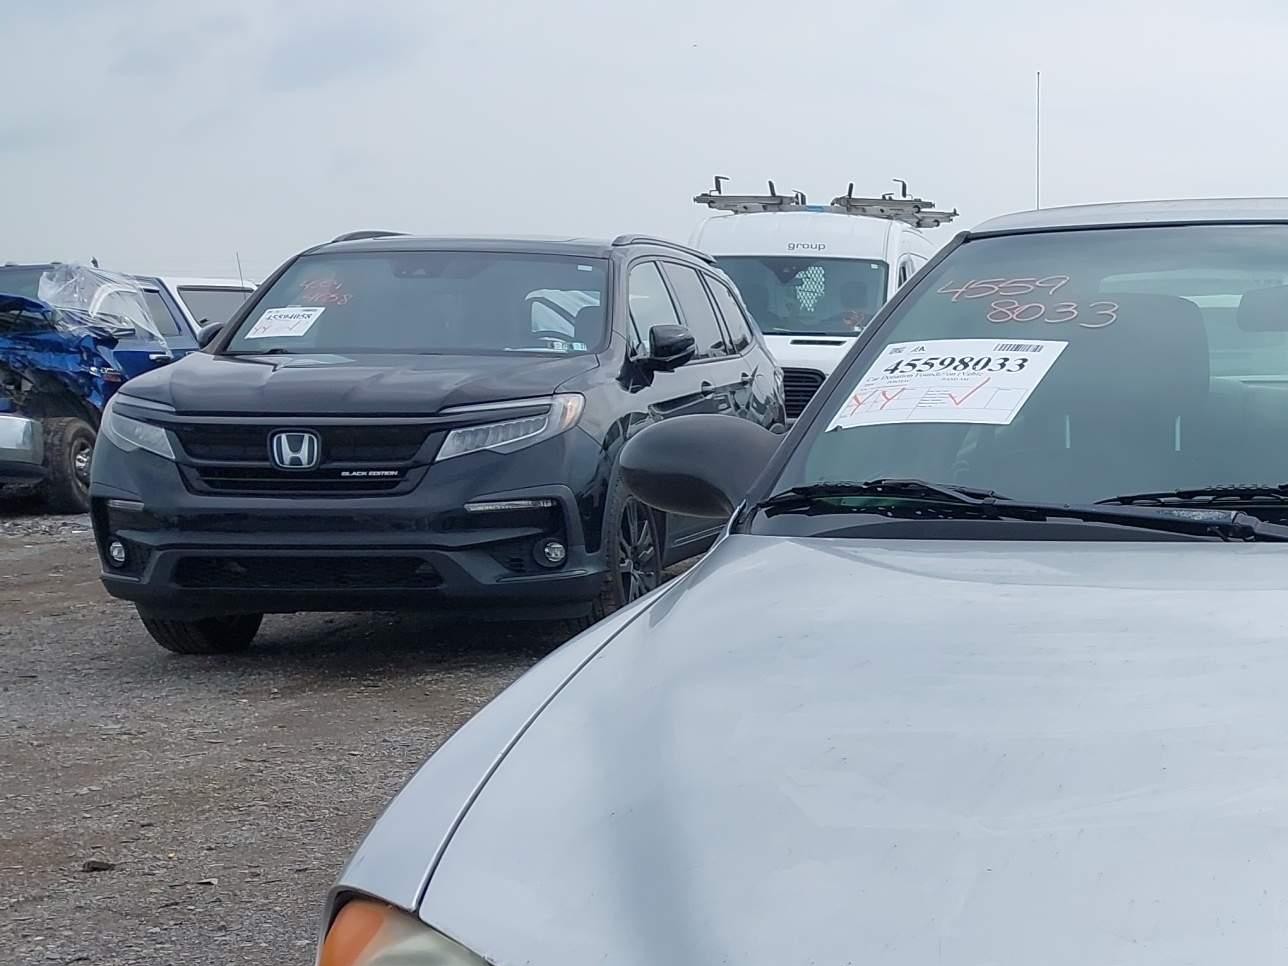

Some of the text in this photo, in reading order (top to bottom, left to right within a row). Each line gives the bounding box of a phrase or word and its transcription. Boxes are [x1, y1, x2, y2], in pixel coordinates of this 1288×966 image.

[787, 242, 826, 251] group
[937, 275, 1070, 302] 4559
[987, 300, 1119, 328] 8033
[883, 357, 1029, 374] 45598033
